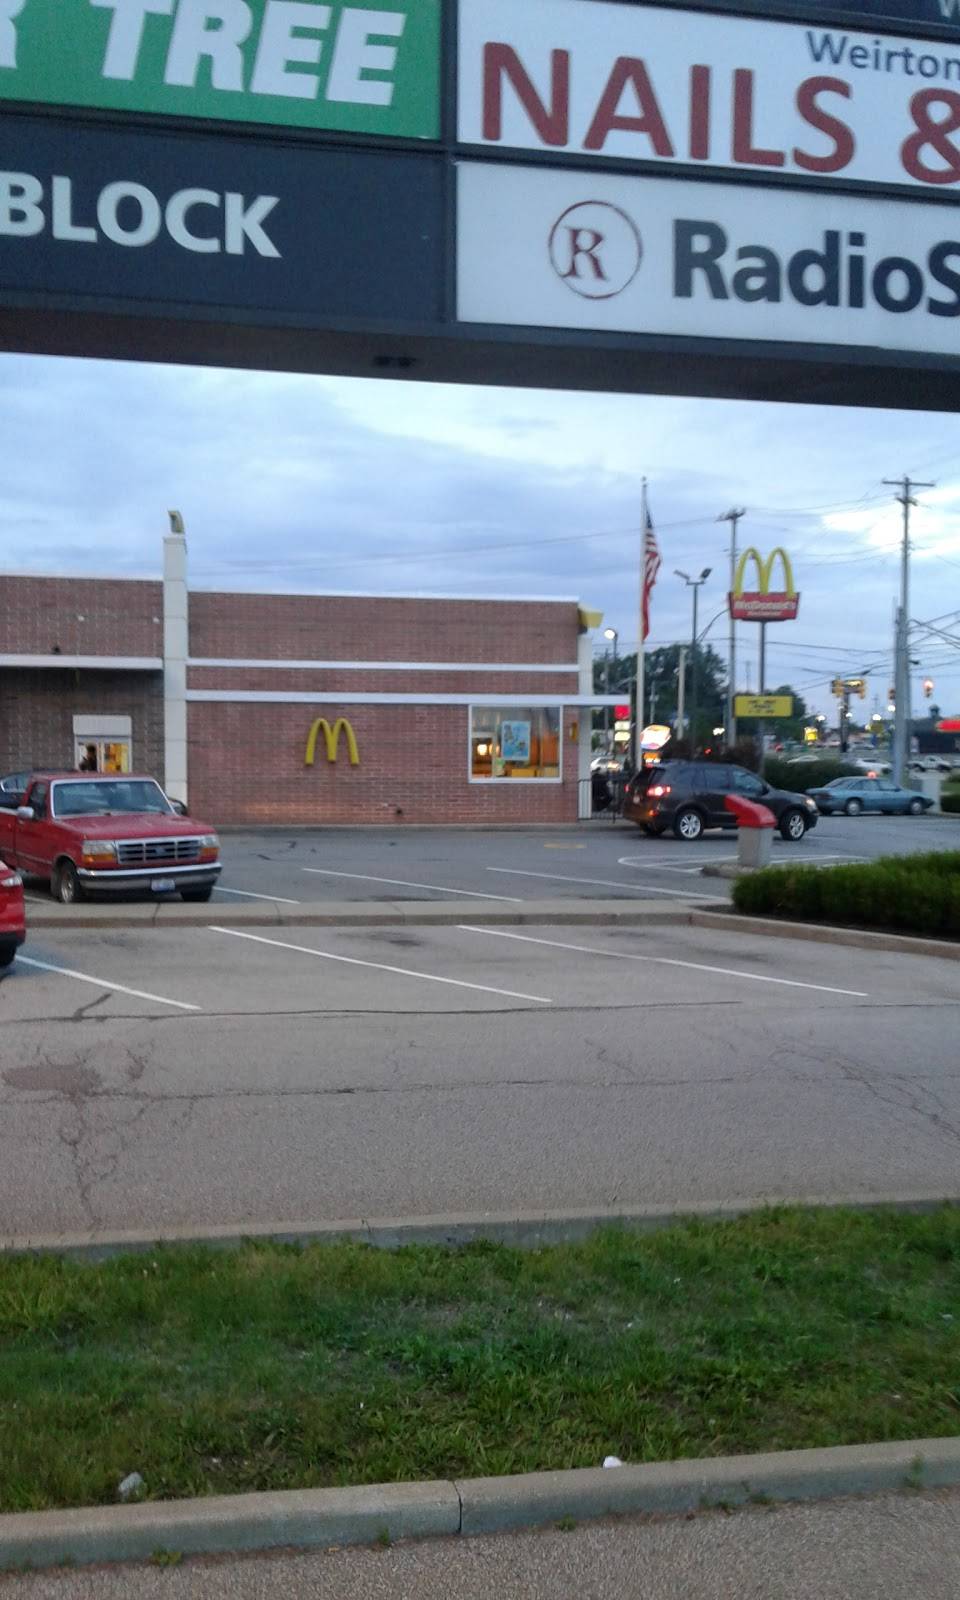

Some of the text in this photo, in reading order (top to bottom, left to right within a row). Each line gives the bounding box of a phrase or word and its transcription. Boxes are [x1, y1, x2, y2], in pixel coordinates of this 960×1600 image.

[90, 0, 407, 106] TREE
[806, 30, 960, 80] Weirton
[483, 41, 856, 173] NAILS
[0, 170, 282, 258] BLOCK
